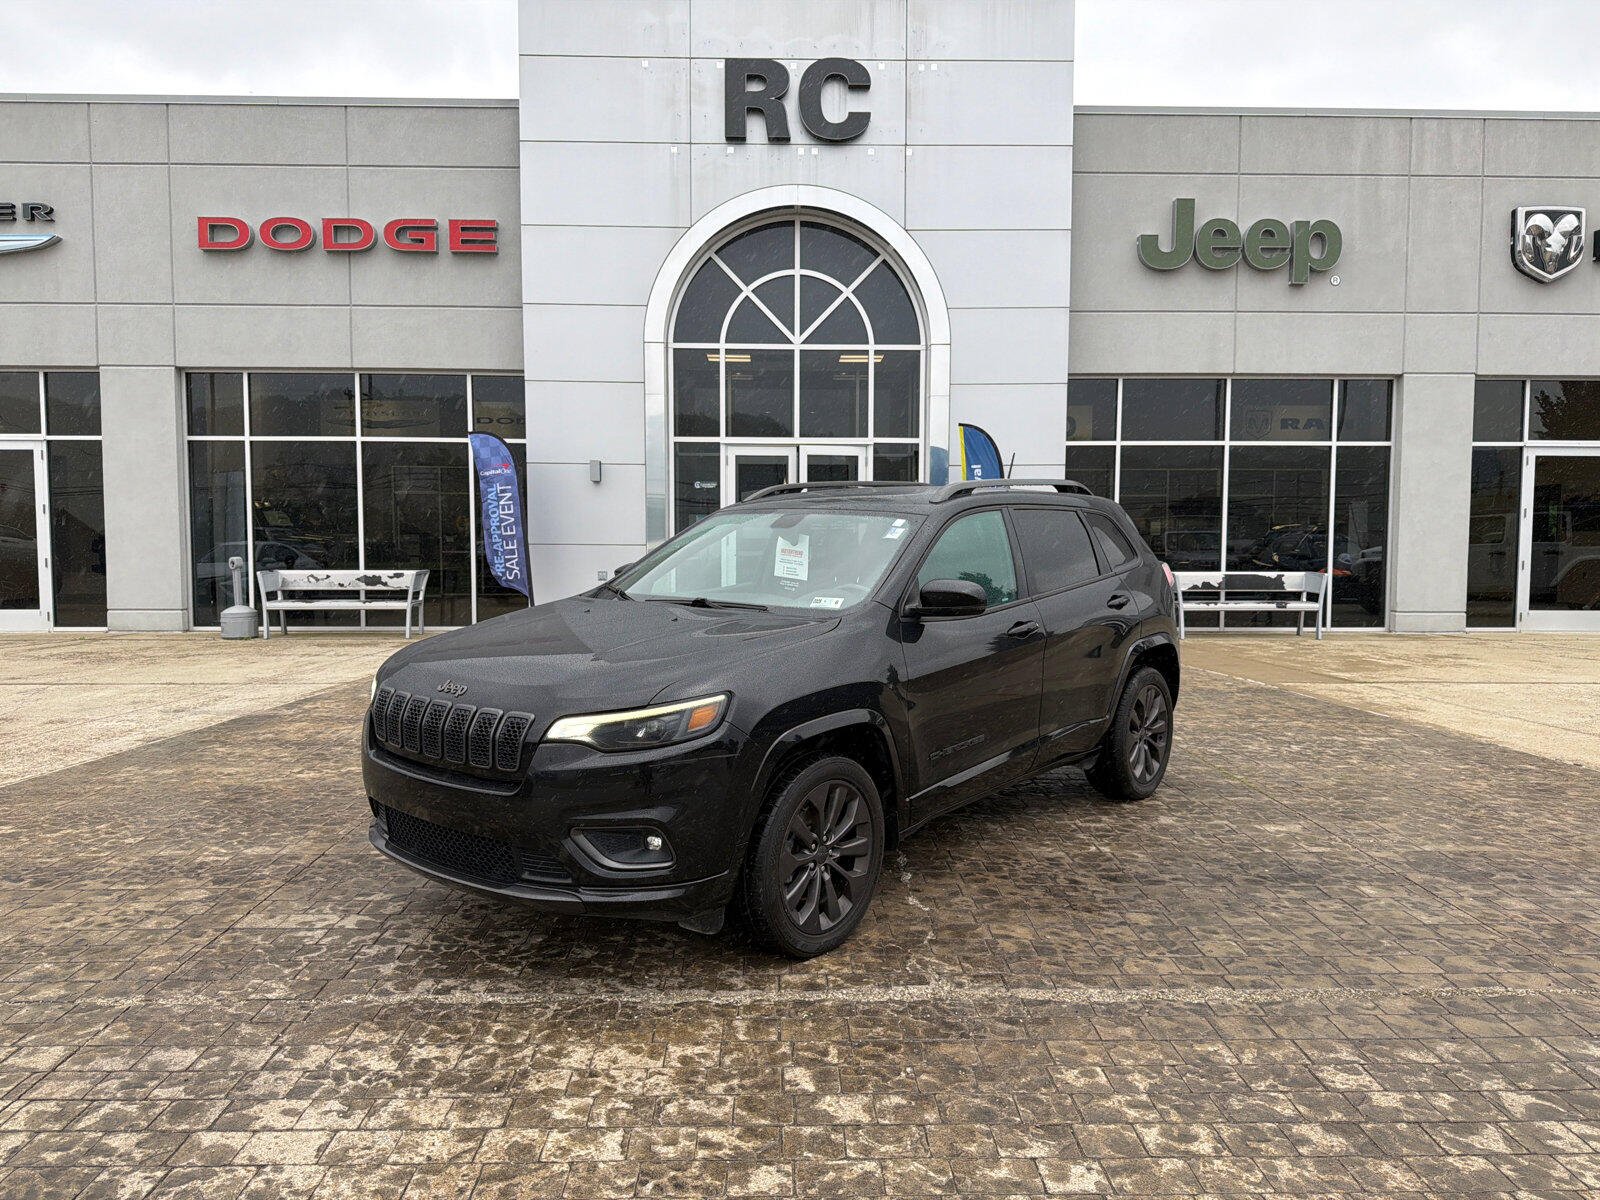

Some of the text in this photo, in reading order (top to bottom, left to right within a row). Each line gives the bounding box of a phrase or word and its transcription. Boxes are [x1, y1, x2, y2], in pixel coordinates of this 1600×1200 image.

[725, 57, 871, 142] RC
[197, 216, 499, 254] DODGE
[1137, 198, 1343, 286] Jeep
[497, 483, 521, 580] SALE EVENT
[437, 679, 468, 698] Jeep
